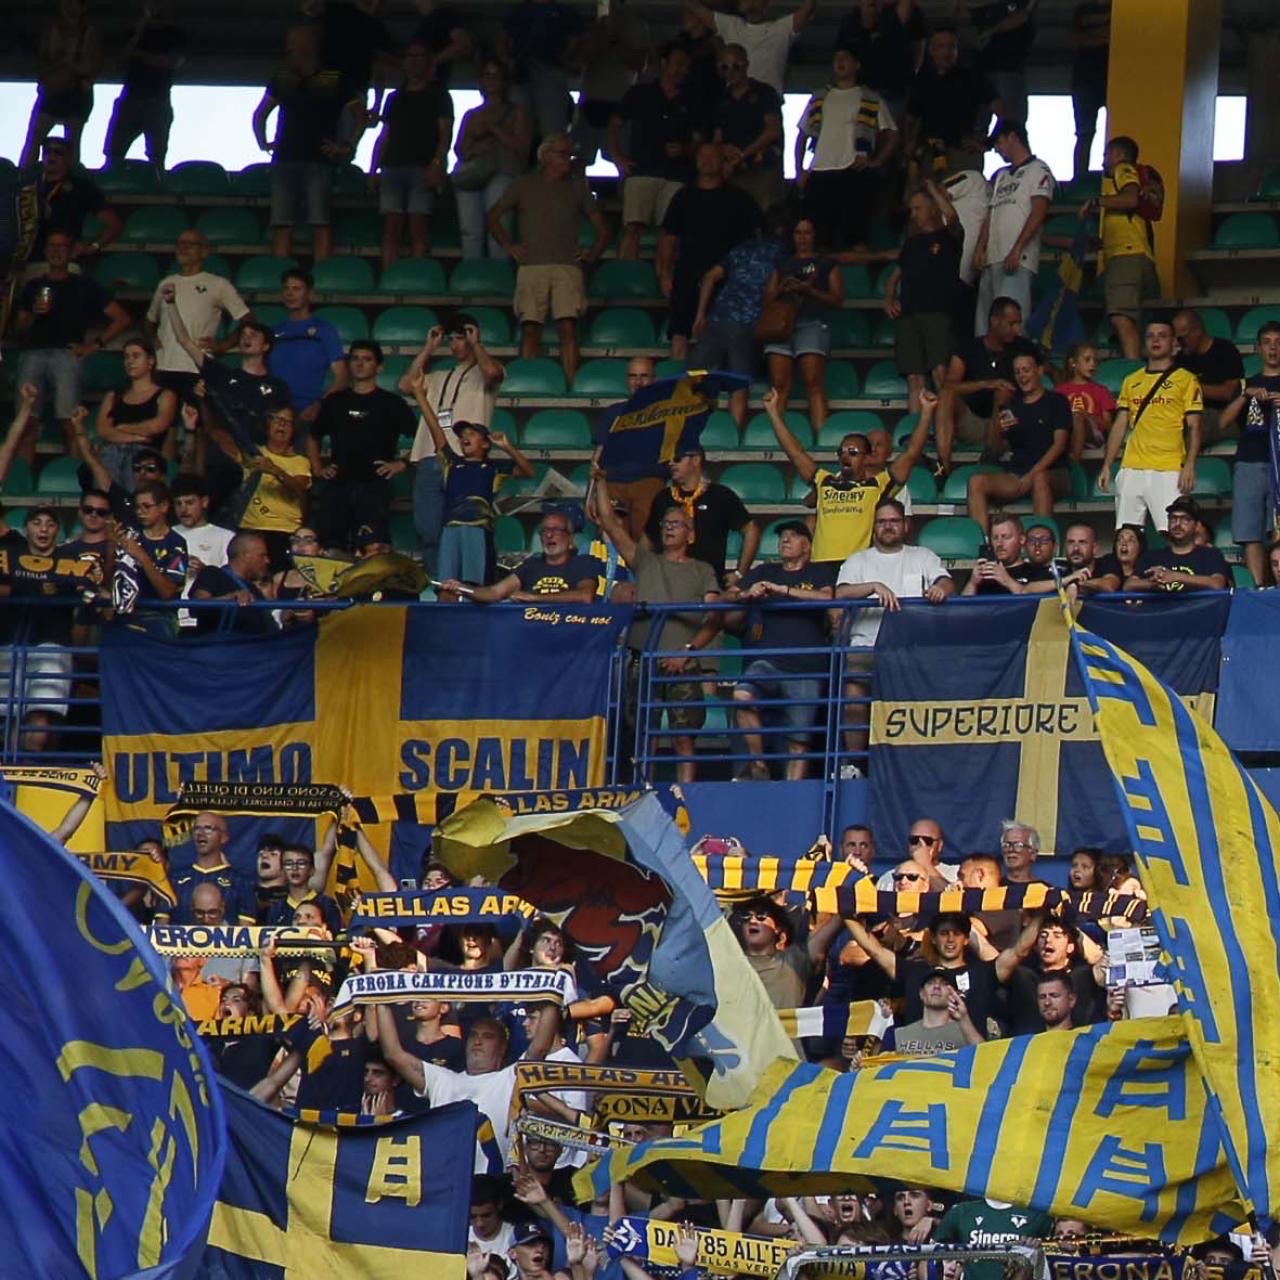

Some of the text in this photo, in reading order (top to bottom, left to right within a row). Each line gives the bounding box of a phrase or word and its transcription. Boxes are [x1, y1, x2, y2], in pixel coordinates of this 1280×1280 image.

[523, 607, 563, 627] Boniz
[886, 704, 1079, 738] SUPERIORE
[114, 738, 591, 804] ULTIMO SCALIN
[580, 787, 644, 812] ARM
[359, 897, 475, 920] HELLAS
[143, 926, 257, 952] VERONA
[346, 975, 408, 995] VERONA
[412, 972, 495, 993] CAMPIONE
[196, 1013, 304, 1037] ARMY
[899, 1040, 955, 1052] HELLAS
[520, 1063, 639, 1088] HELLAS
[697, 1256, 742, 1269] ELLAS
